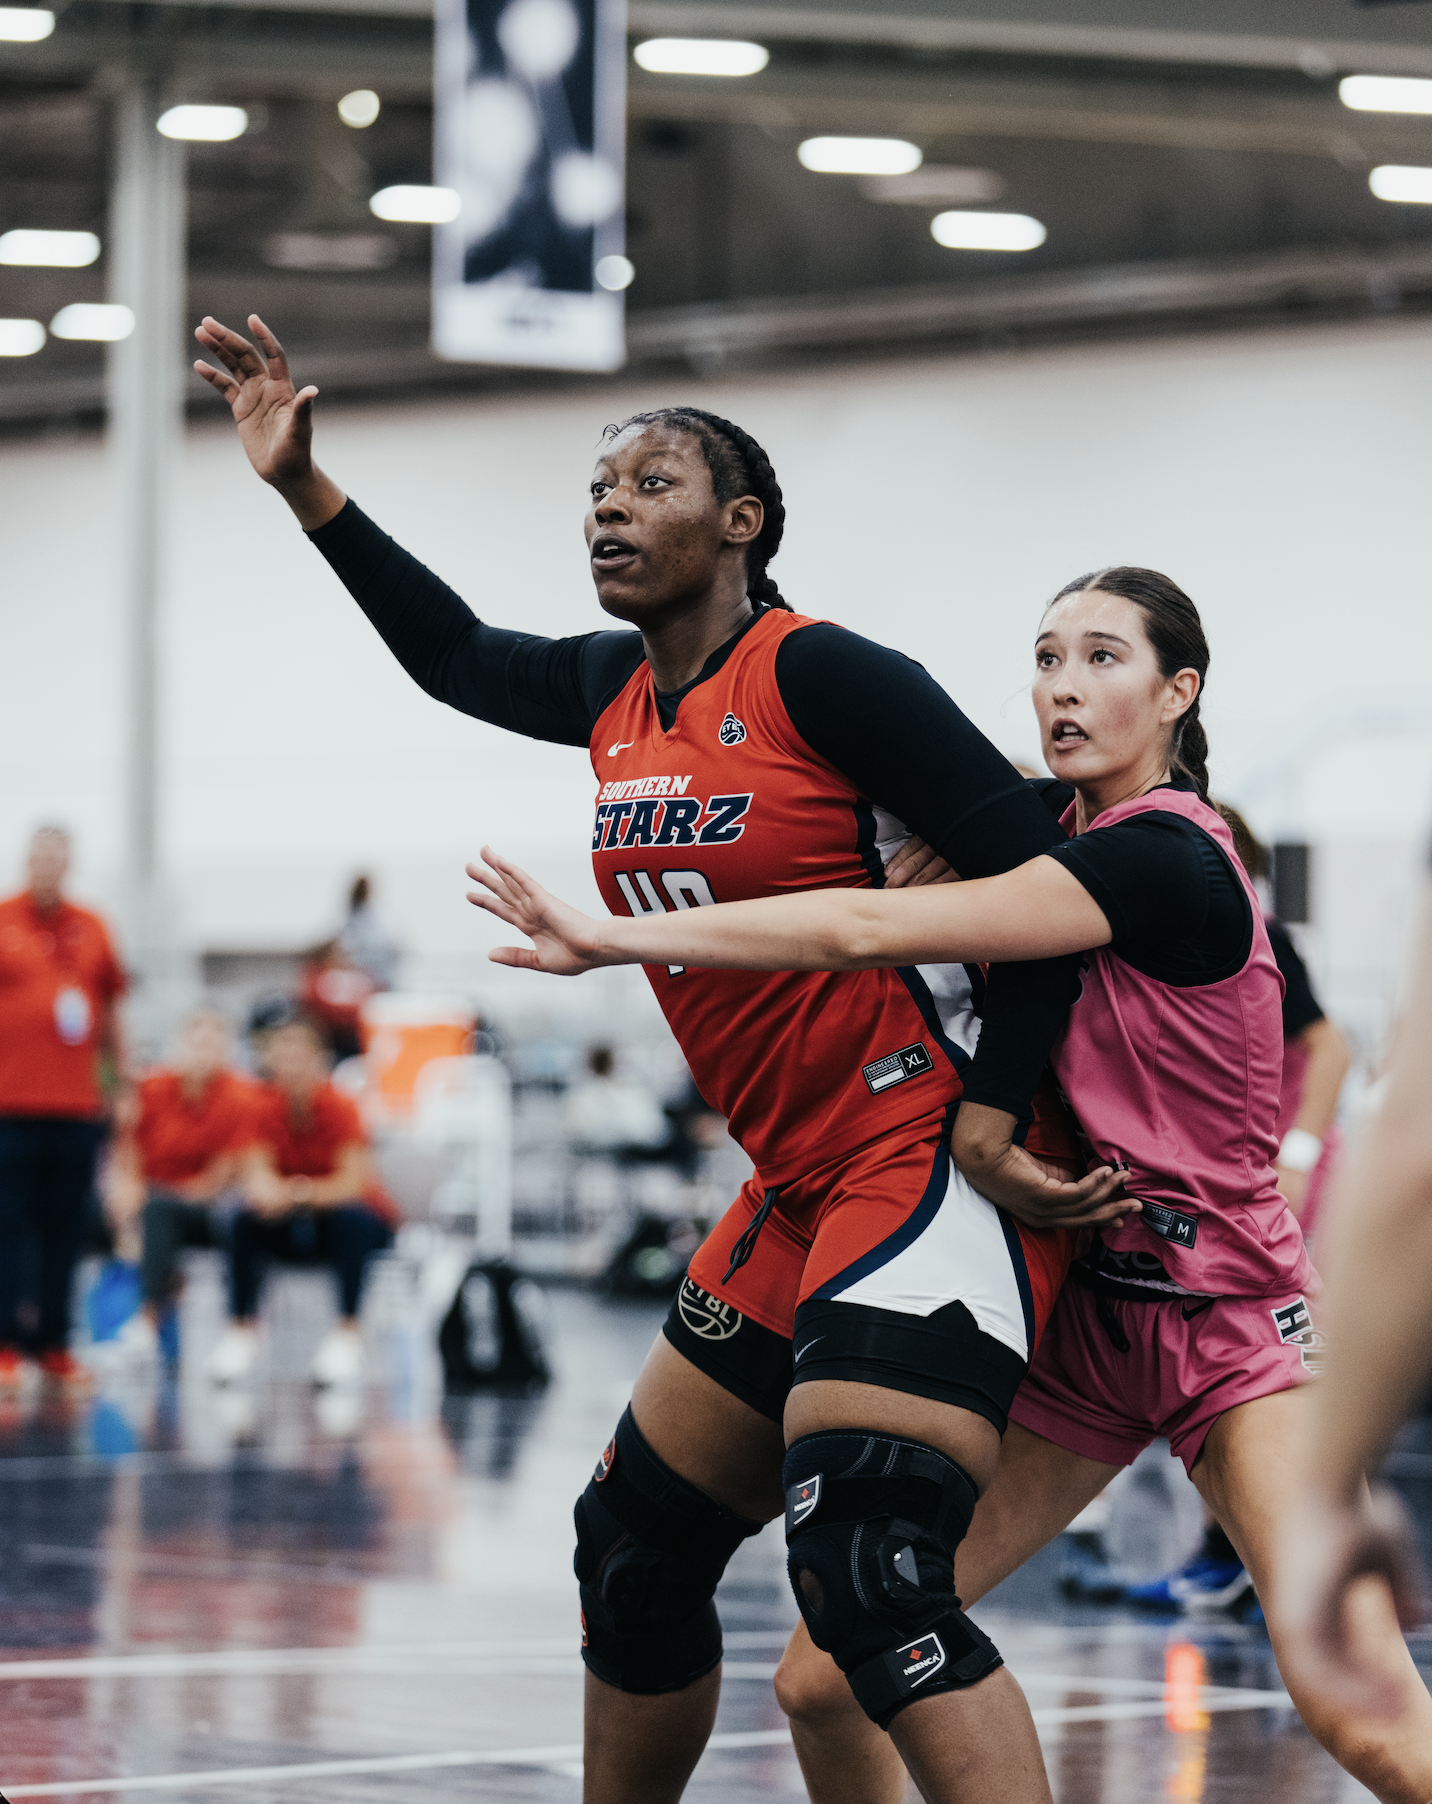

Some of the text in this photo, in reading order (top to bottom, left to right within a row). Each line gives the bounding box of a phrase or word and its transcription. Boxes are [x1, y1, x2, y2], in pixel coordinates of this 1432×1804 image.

[599, 775, 693, 801] SOUTHERN
[592, 793, 754, 852] STARZ
[904, 1053, 925, 1069] XL
[1177, 1222, 1189, 1237] M
[903, 1653, 941, 1676] NEENCA
